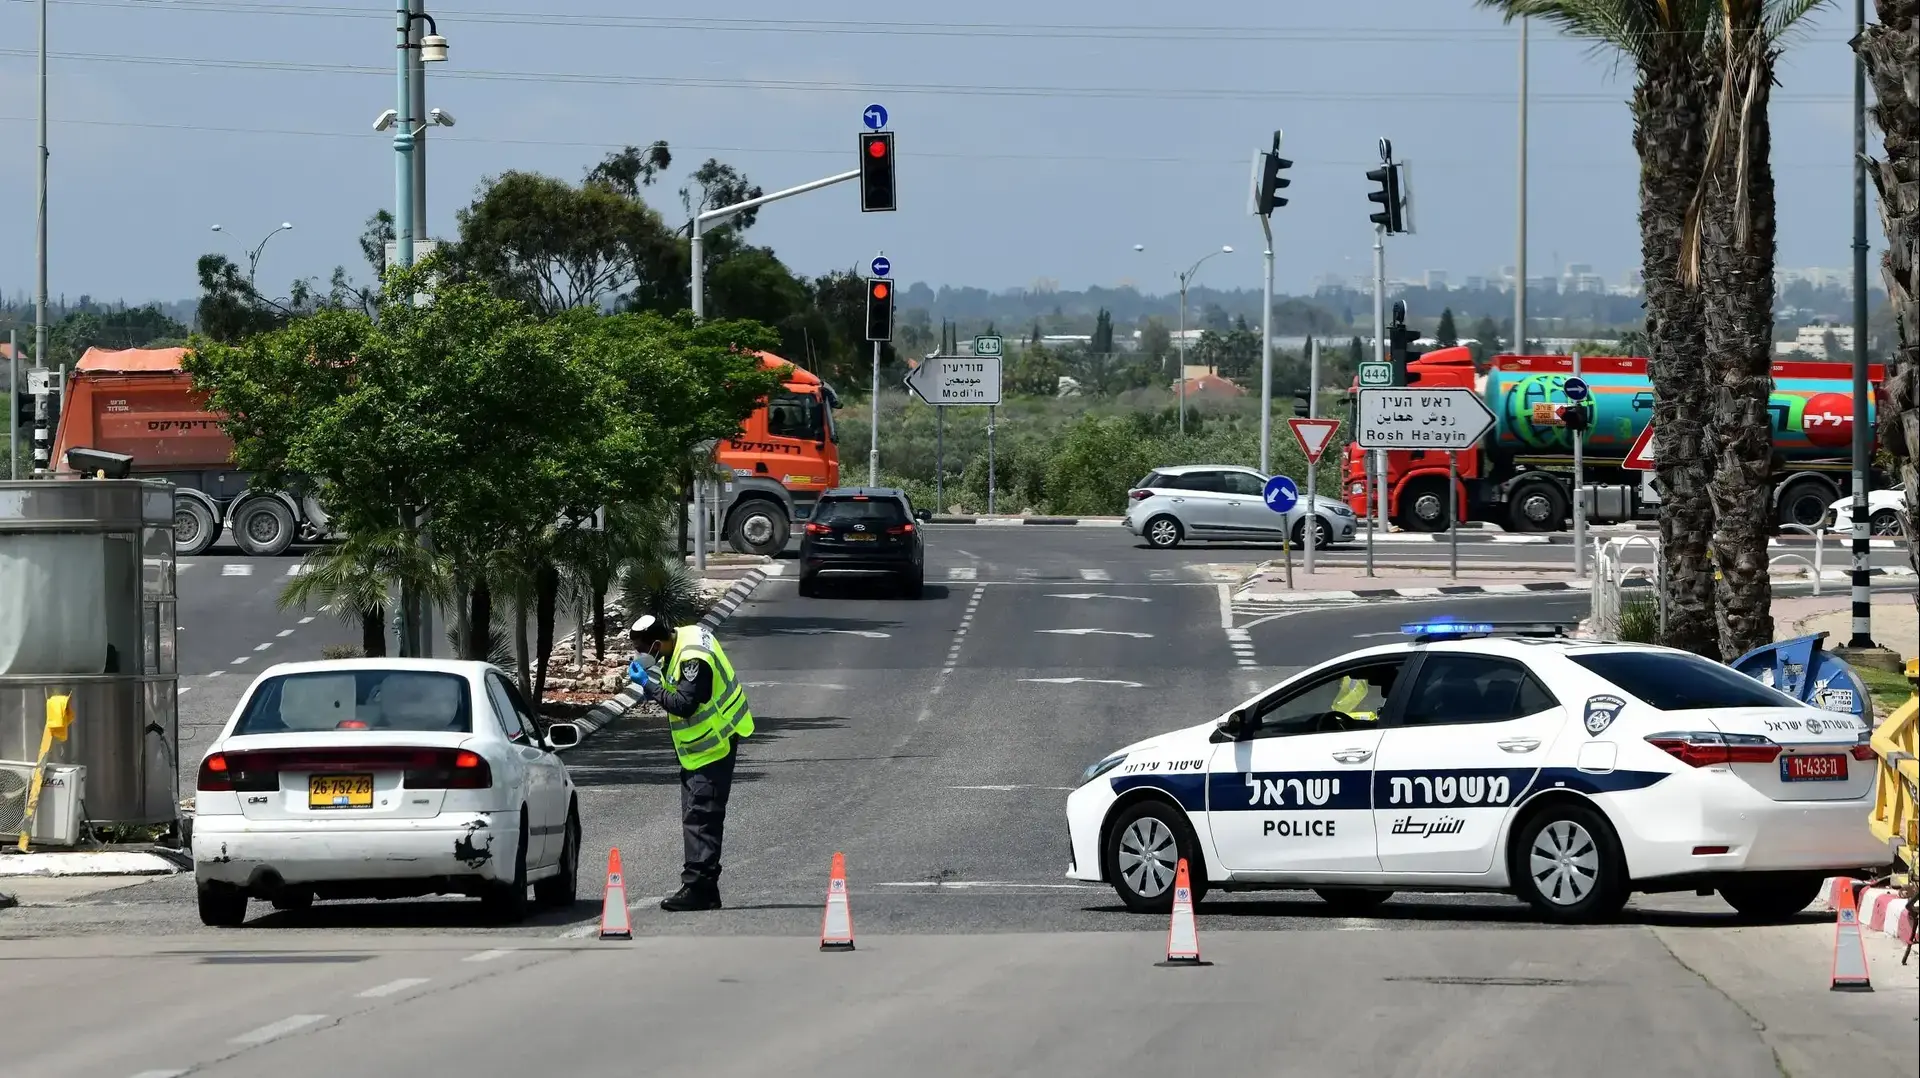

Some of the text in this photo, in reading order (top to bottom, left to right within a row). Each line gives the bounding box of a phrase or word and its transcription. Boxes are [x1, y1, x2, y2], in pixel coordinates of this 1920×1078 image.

[979, 342, 997, 351] 444
[943, 364, 983, 374] מודיעין
[1364, 369, 1387, 379] 444
[945, 377, 981, 386] موديعين
[943, 389, 984, 398] Modi'in
[1382, 397, 1451, 409] ראש העין
[1377, 412, 1455, 426] روش هعاين
[1367, 430, 1466, 443] Rosh Ha'ayin
[1764, 720, 1802, 731] ישראל
[1822, 720, 1854, 729] משטרת
[1125, 759, 1204, 773] שיטור עירוני
[1245, 772, 1510, 806] משטרת ישראל
[1263, 820, 1336, 837] POLICE
[1391, 815, 1466, 839] الشرطة
